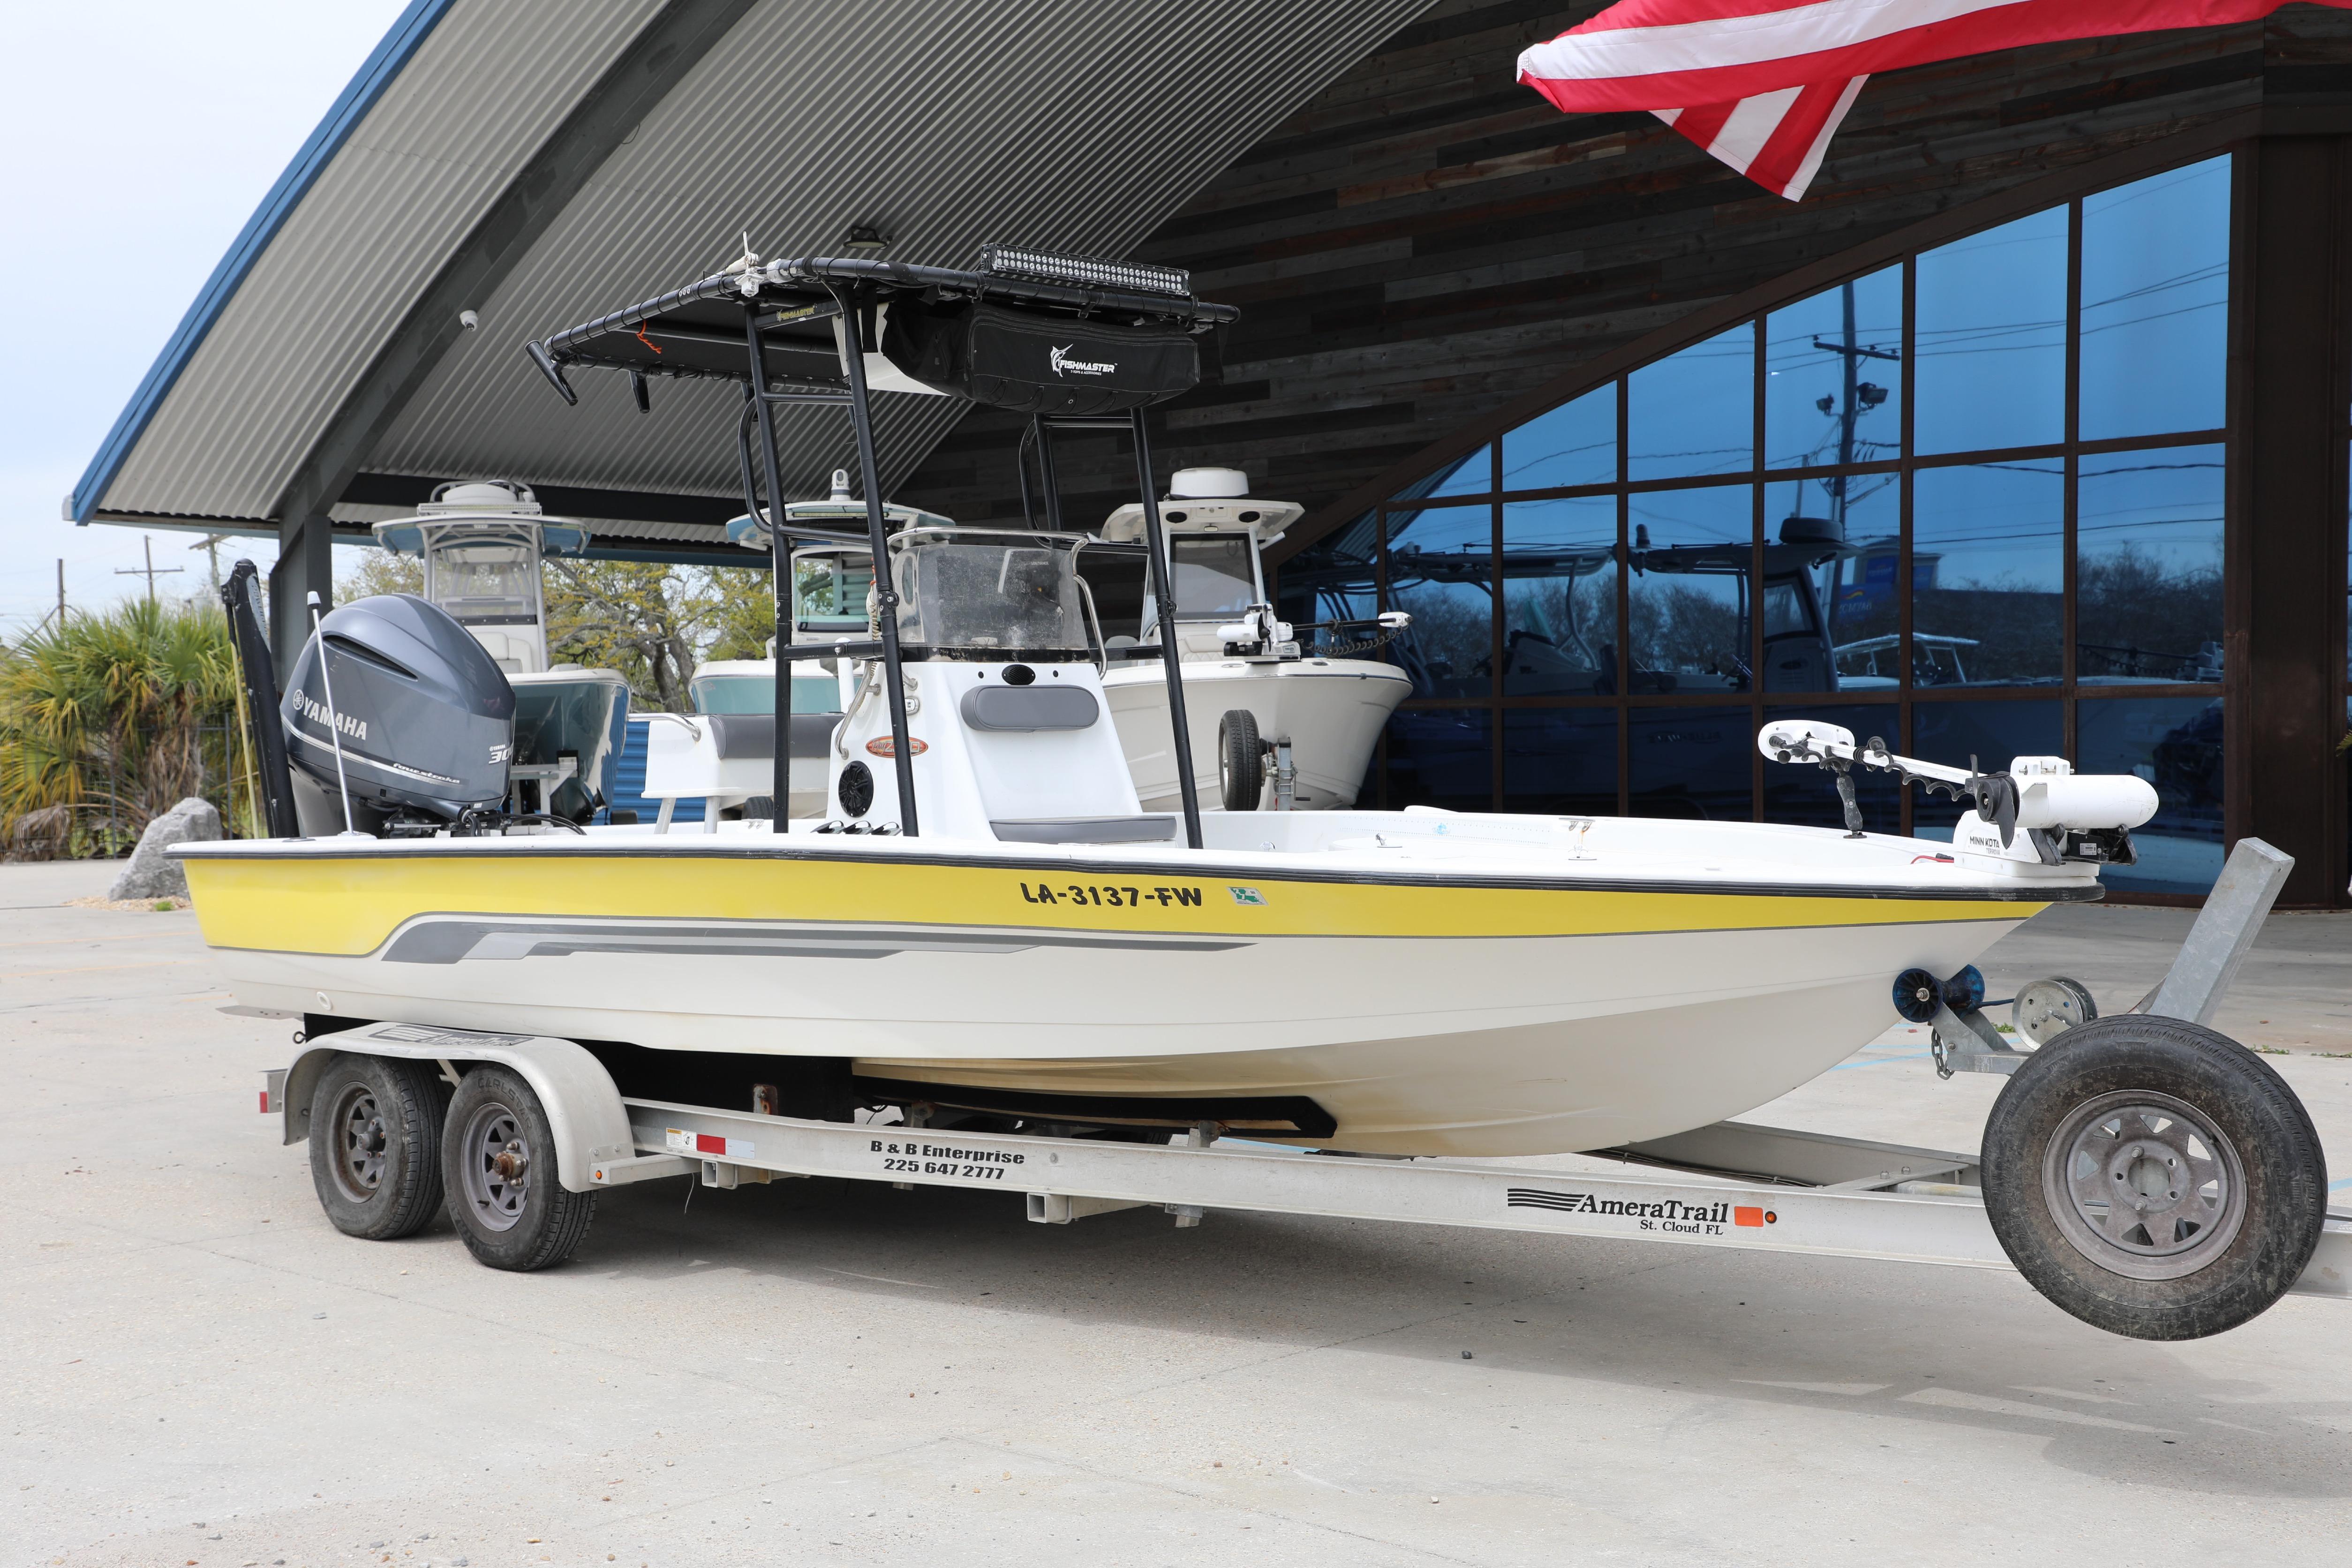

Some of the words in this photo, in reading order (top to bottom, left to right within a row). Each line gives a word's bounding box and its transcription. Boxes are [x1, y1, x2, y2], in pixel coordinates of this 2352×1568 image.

[1060, 360, 1115, 373] FISHMASTER
[303, 697, 367, 740] YAMAHA
[1970, 836, 1984, 846] MINN
[1985, 838, 1999, 848] KOTA
[1020, 882, 1201, 906] LA-3137-FW
[477, 1077, 533, 1130] CARLSTAR
[871, 1140, 882, 1152] B
[887, 1144, 900, 1154] &
[905, 1143, 917, 1155] B
[922, 1145, 1025, 1164] Enterprise
[884, 1158, 919, 1172] 225
[924, 1162, 958, 1175] 647
[962, 1165, 1004, 1179] 2777
[1577, 1194, 1729, 1223] AmeraTrail
[1640, 1220, 1657, 1230] St.
[1662, 1221, 1700, 1234] Cloud
[1705, 1224, 1724, 1235] FL
